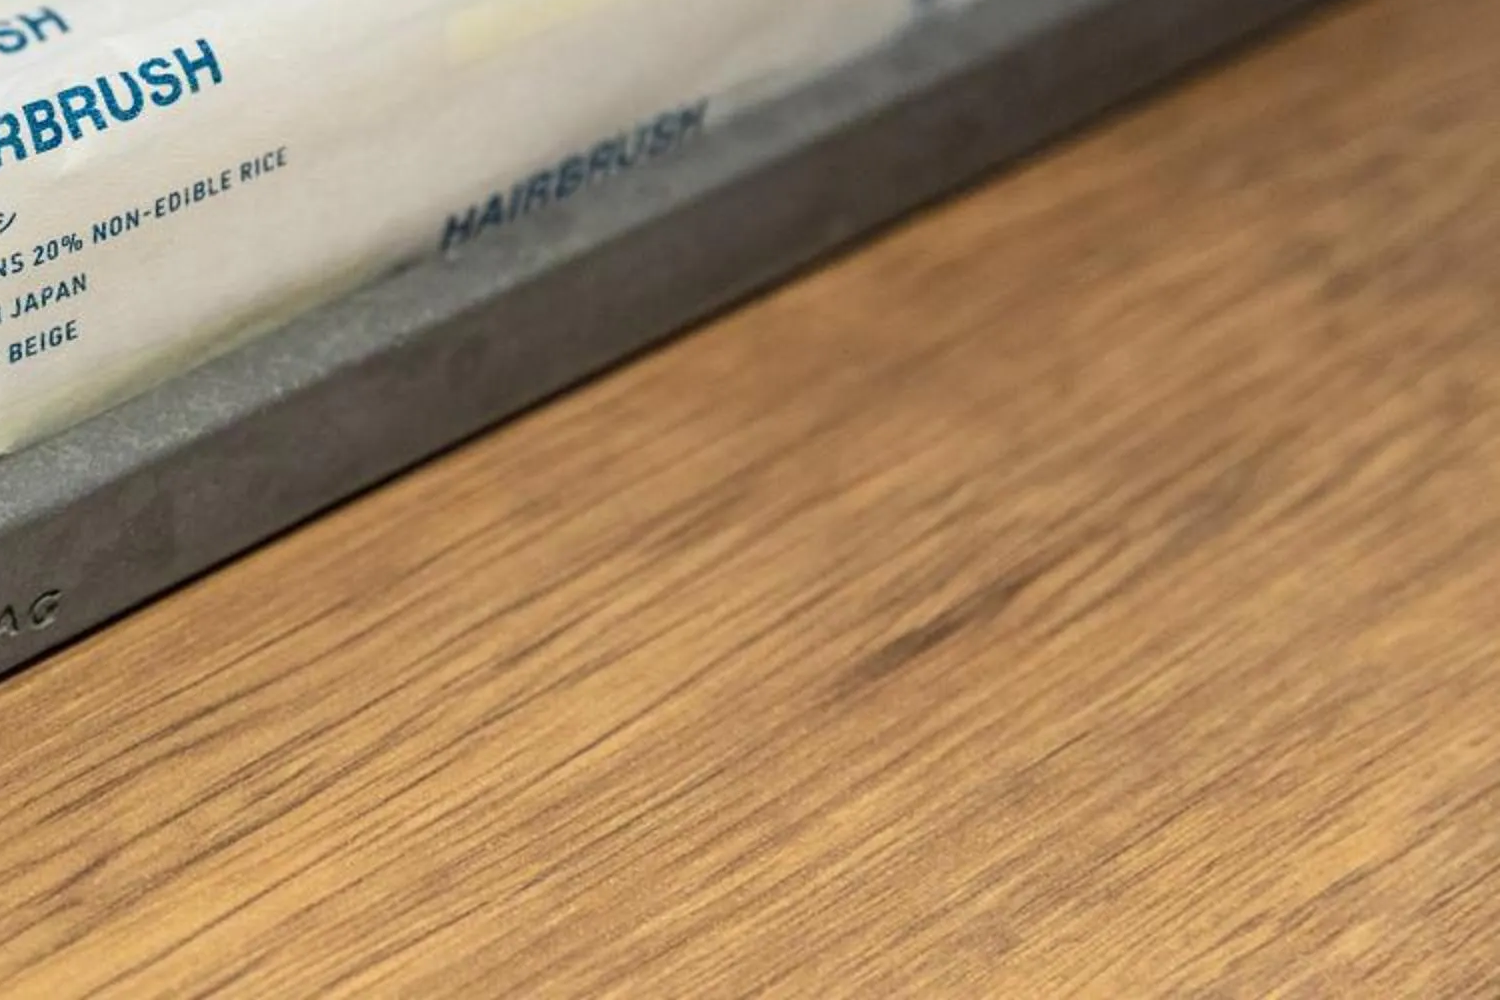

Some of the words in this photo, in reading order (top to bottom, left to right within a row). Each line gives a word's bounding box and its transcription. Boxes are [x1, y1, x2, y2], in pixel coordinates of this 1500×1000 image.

[32, 232, 84, 268] 20%
[92, 169, 232, 244] NON-EDIBLE
[239, 145, 289, 183] RICE
[10, 272, 88, 319] JAPAN
[8, 319, 80, 364] BEIGE
